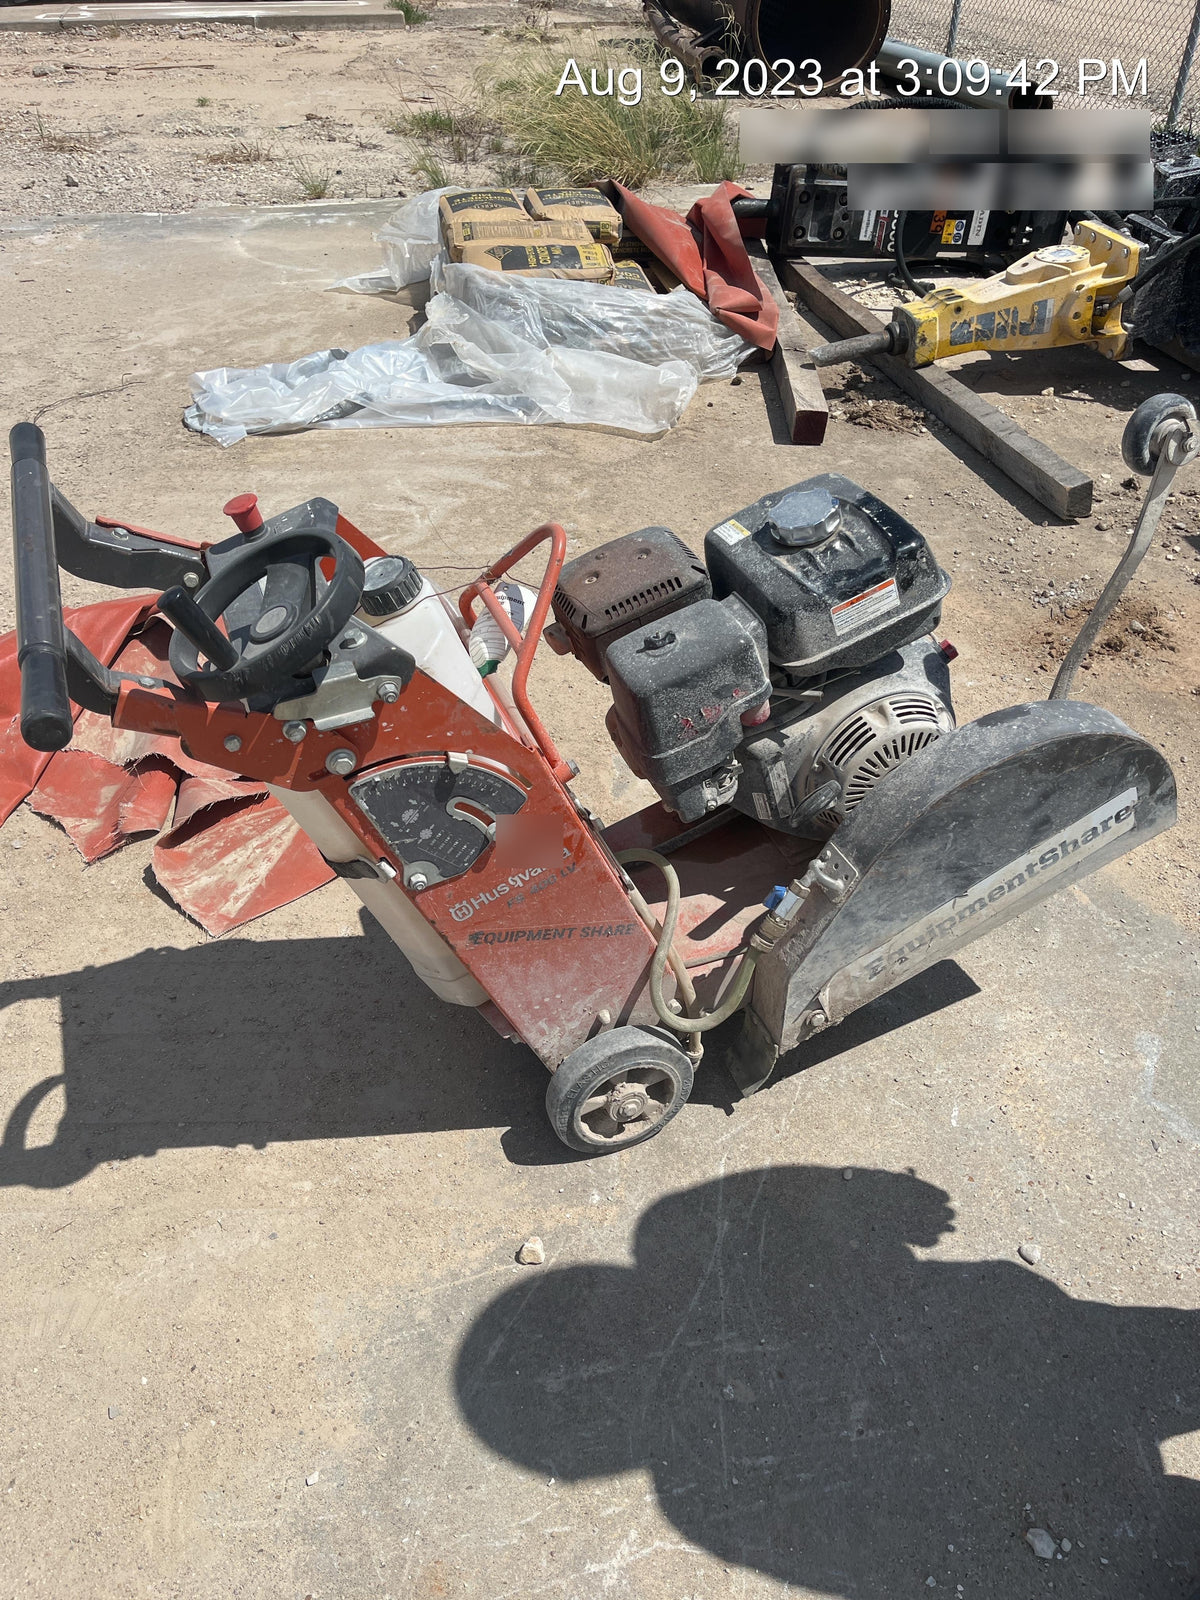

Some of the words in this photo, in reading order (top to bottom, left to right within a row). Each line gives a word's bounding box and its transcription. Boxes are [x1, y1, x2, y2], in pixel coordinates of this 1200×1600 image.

[471, 847, 572, 910] Husqvaa
[863, 804, 1135, 981] EquipmentShare
[468, 926, 578, 946] EQUIPMENT
[579, 923, 639, 939] SHARE
